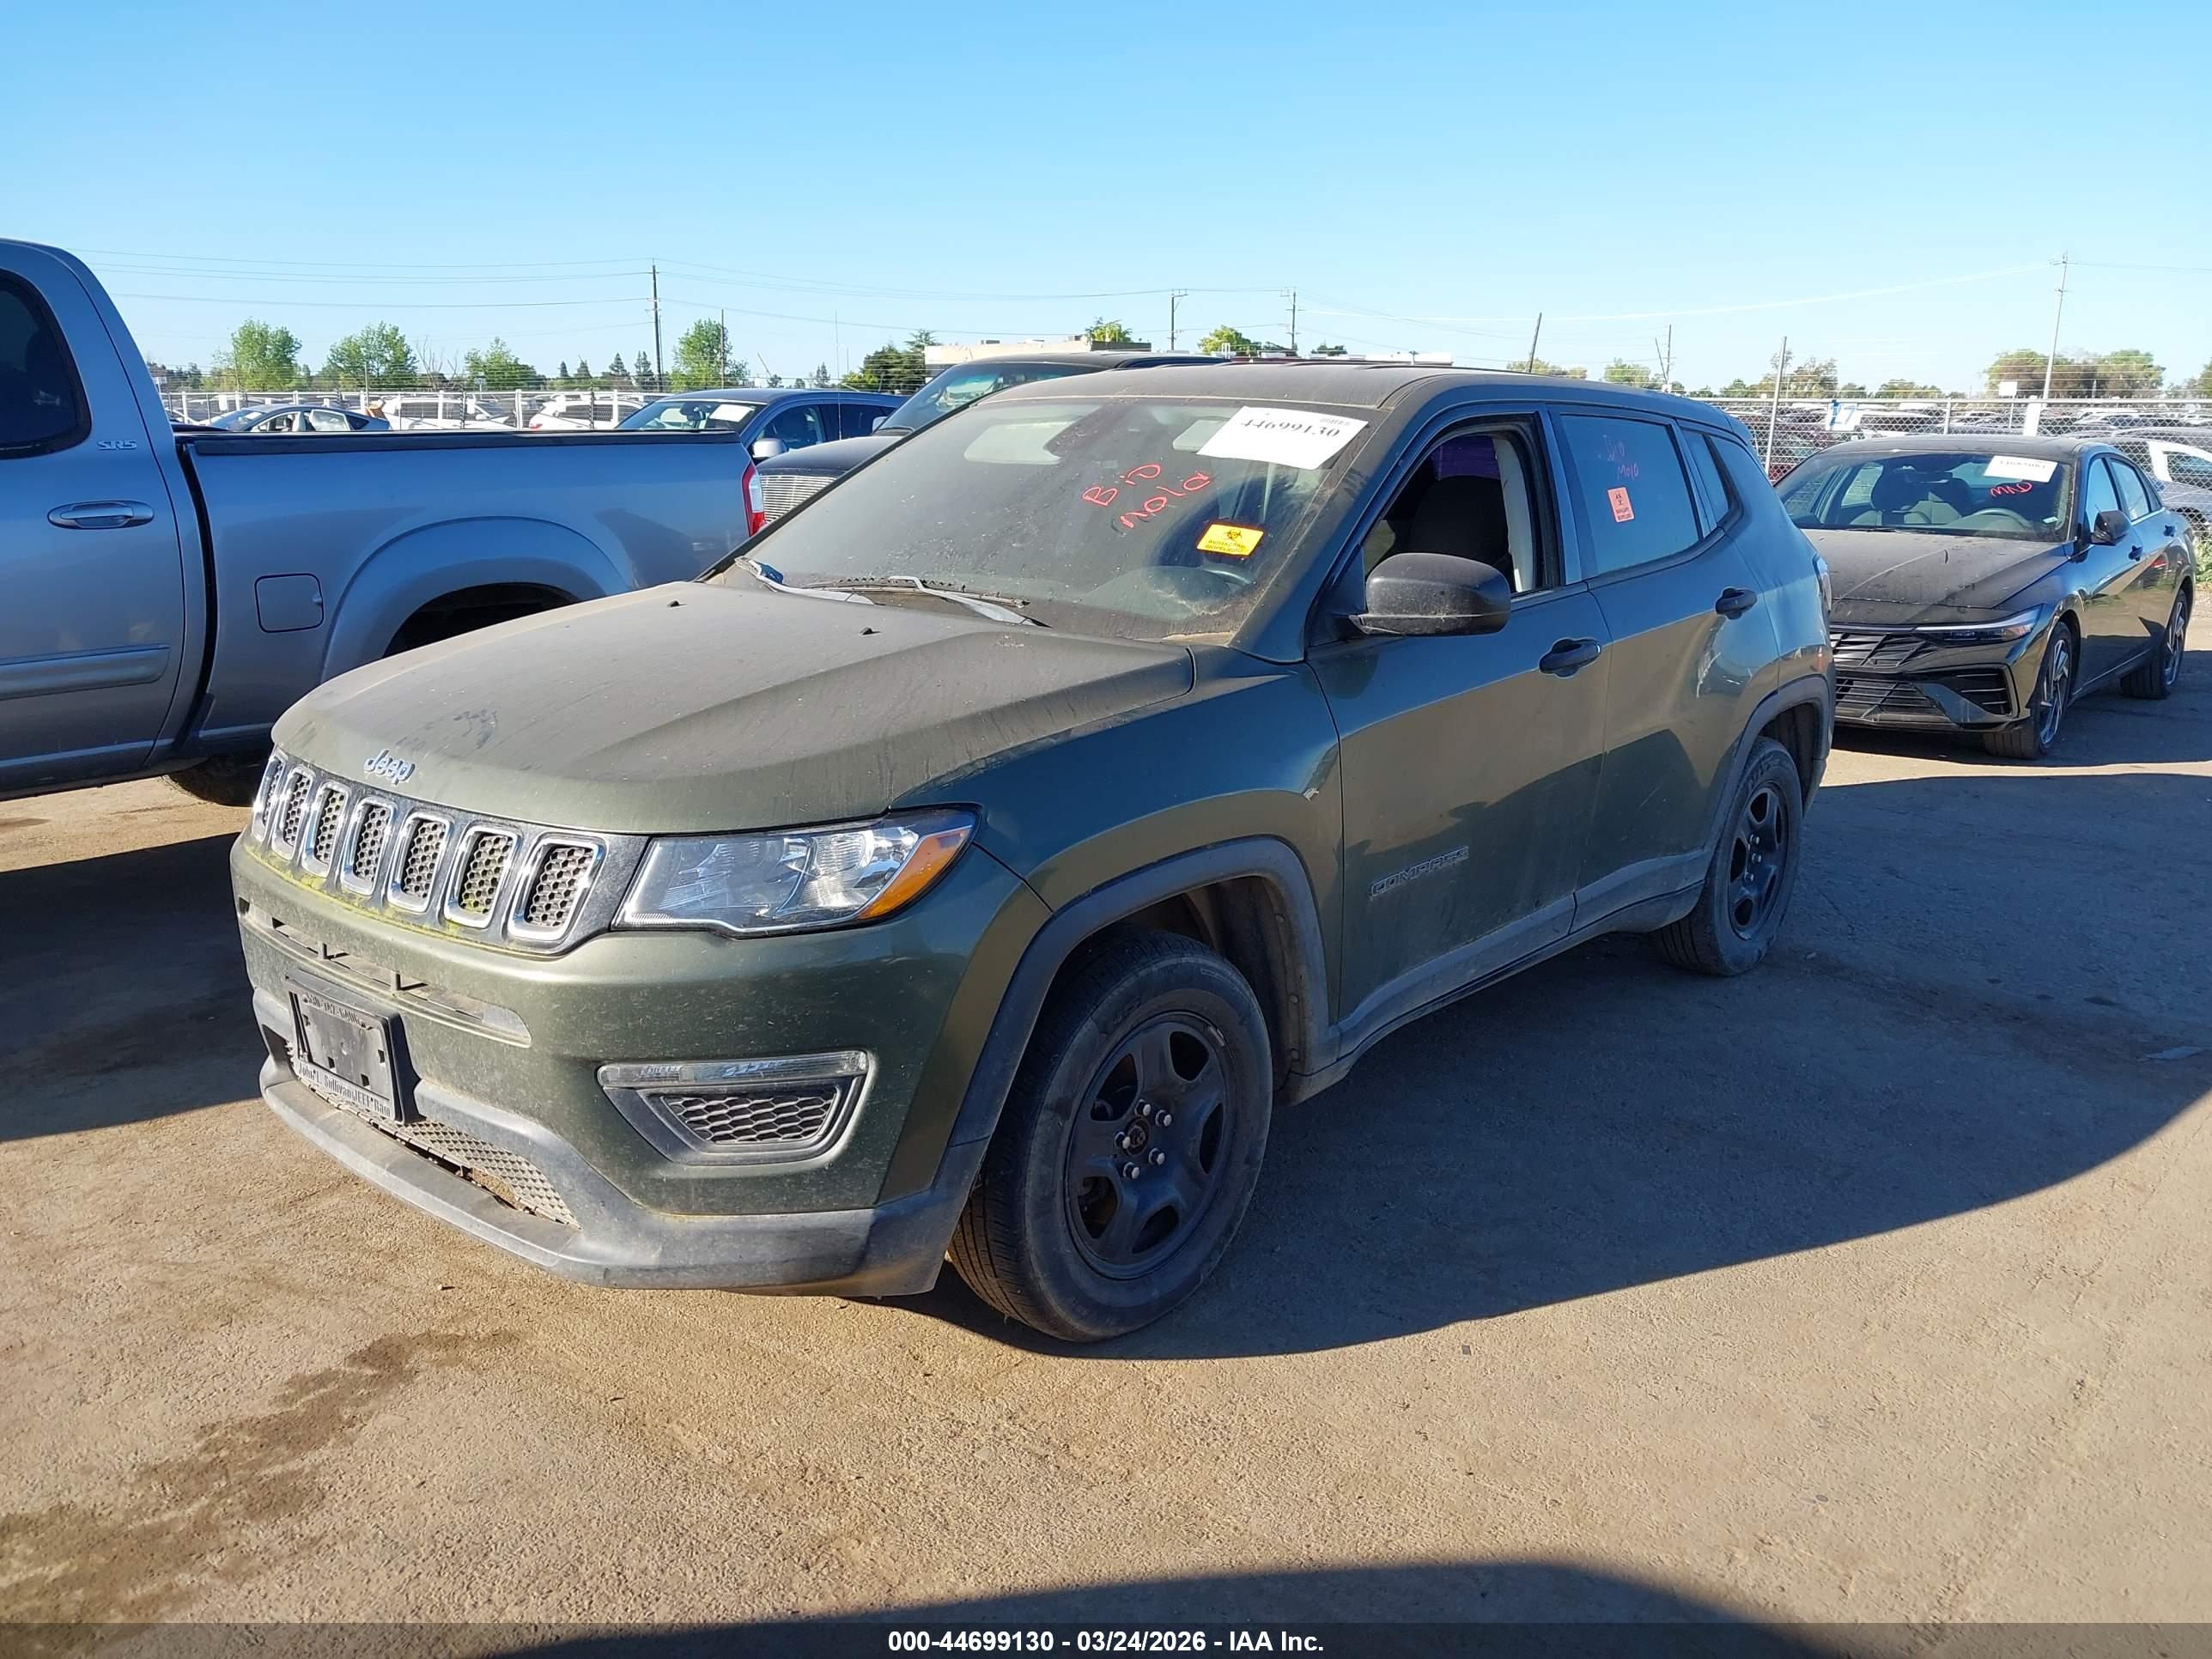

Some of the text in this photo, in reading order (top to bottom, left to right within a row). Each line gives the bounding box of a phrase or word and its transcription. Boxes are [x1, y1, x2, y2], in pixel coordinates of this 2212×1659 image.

[1242, 418, 1341, 437] 44699130
[97, 439, 137, 451] SR5
[364, 748, 416, 786] Jeep
[1370, 845, 1469, 898] COMPASS
